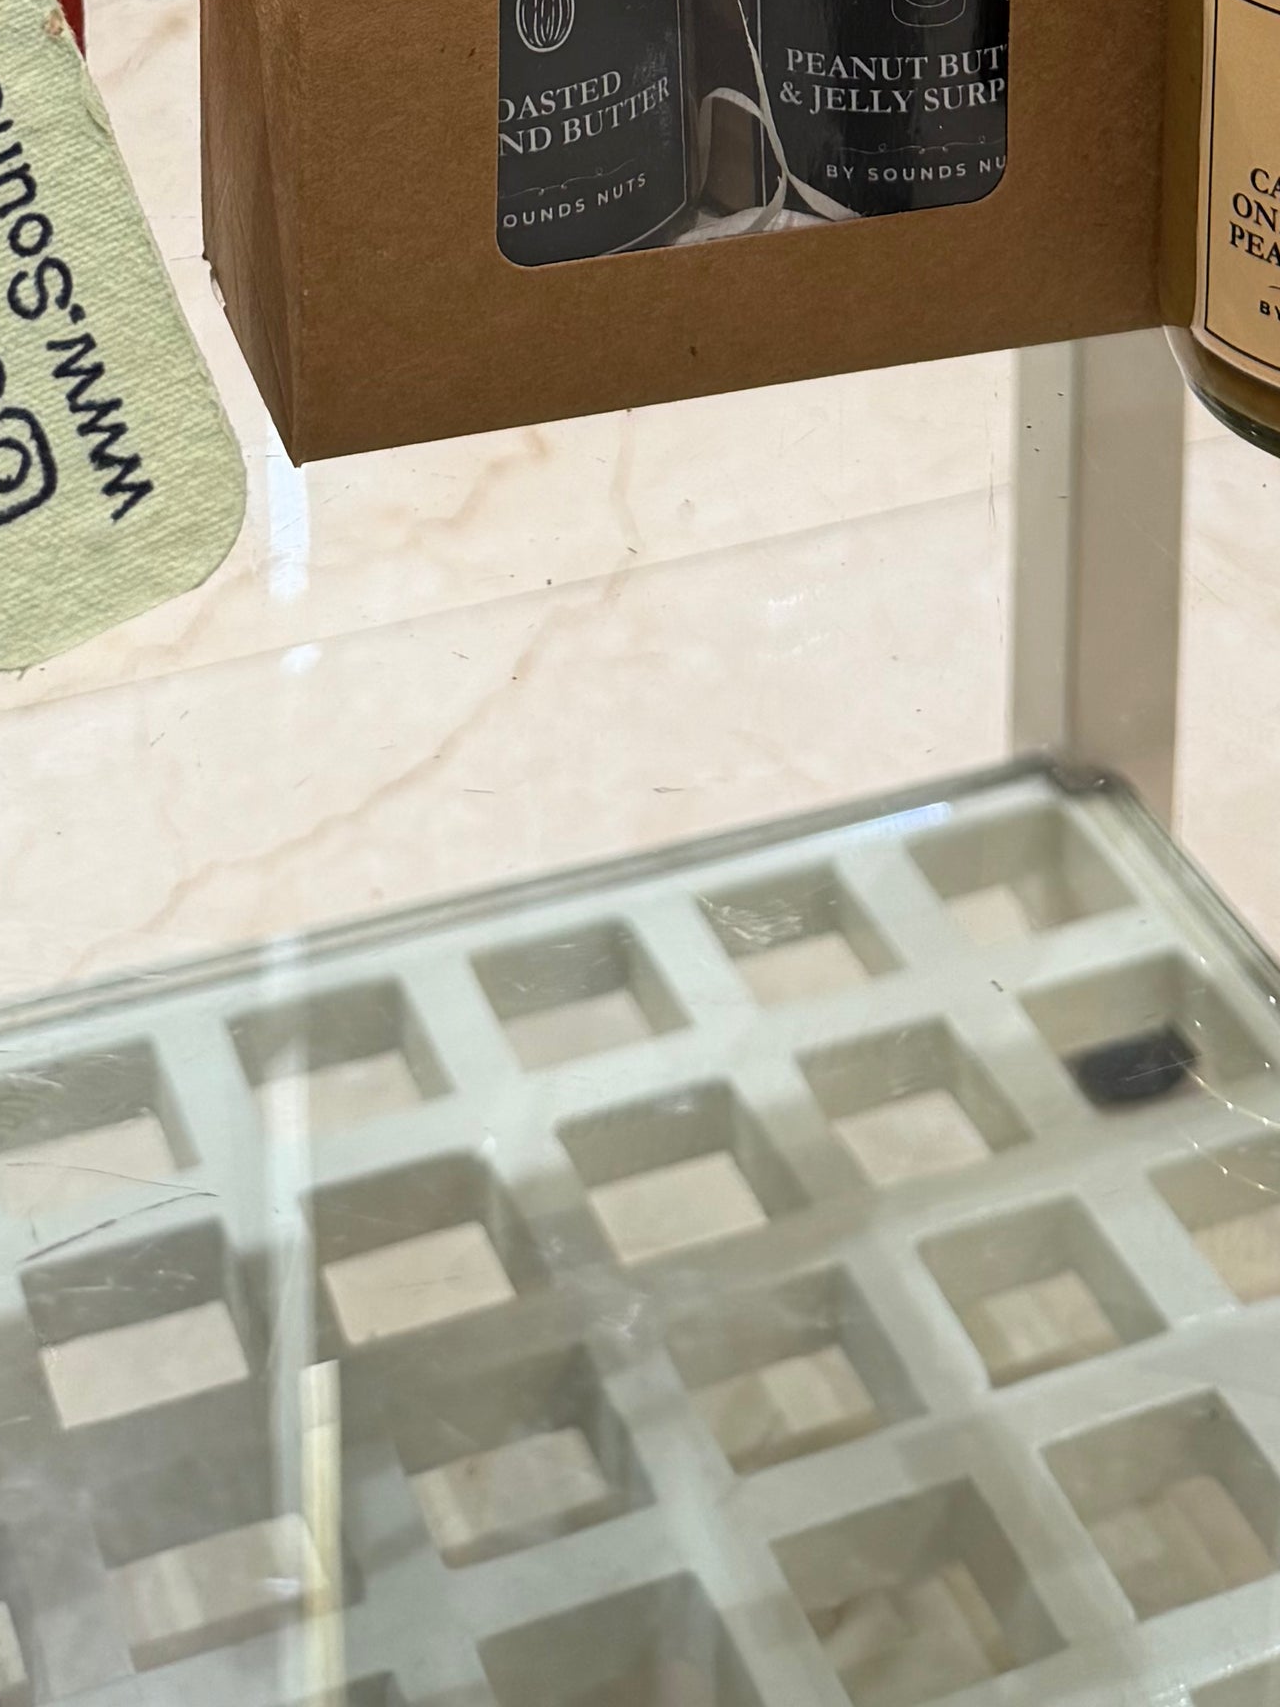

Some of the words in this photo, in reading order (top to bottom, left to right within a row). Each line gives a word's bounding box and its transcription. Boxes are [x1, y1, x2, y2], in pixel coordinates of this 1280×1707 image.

[785, 47, 928, 81] PEANUT
[562, 76, 670, 145] BUTTER
[779, 81, 803, 105] &
[810, 84, 915, 115] JELLY
[826, 164, 854, 179] BY
[868, 163, 967, 181] SOUNDS
[597, 173, 646, 206] NUTS
